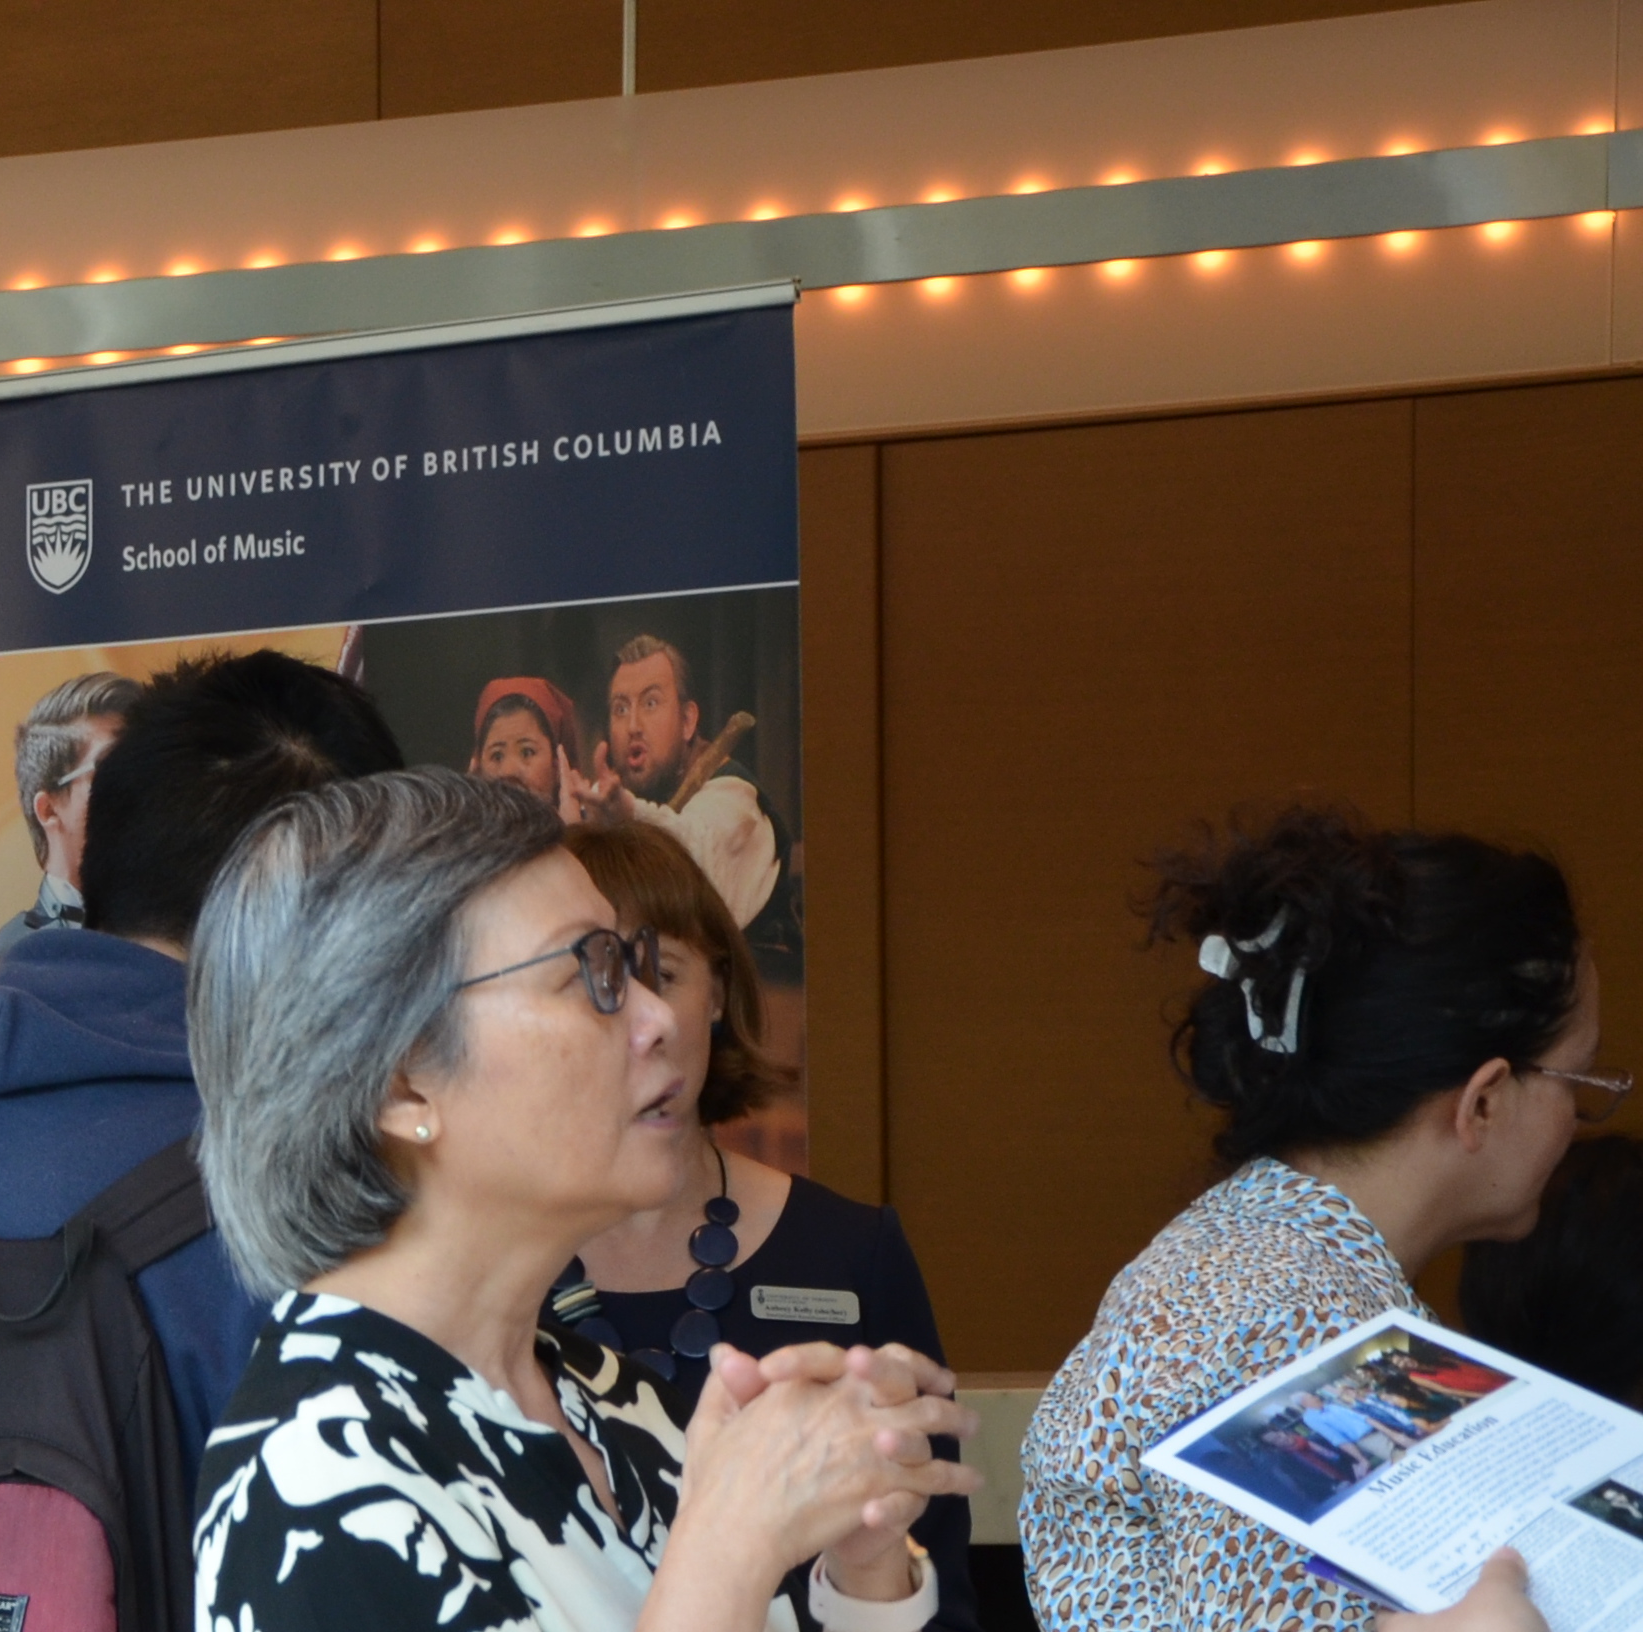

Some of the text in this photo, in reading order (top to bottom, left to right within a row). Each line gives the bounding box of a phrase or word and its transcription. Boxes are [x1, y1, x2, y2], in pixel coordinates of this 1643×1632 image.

[121, 420, 722, 507] THE UNIVERSITY OF BRITISH COLUMBIA
[32, 487, 86, 516] UBC
[122, 530, 305, 571] School of Music
[1367, 1413, 1499, 1497] Music Education
